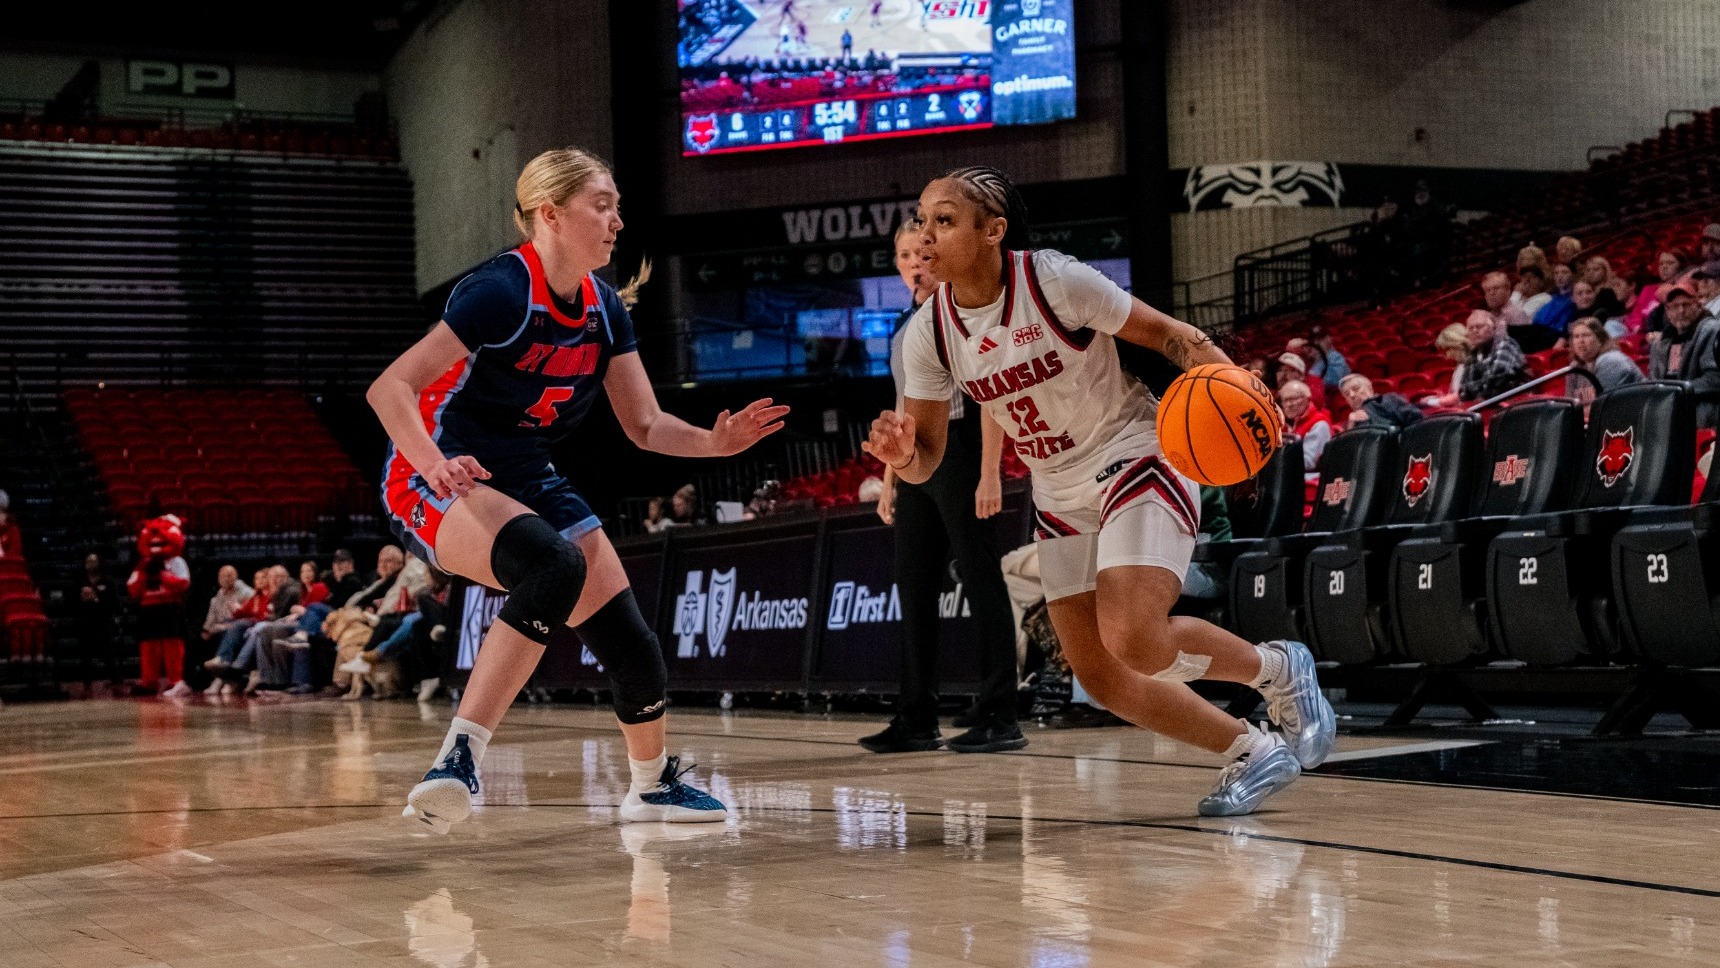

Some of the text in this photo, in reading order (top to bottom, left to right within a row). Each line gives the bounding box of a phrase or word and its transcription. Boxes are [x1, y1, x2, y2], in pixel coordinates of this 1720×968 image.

[995, 18, 1067, 42] GARNER
[128, 60, 230, 94] PP
[814, 100, 856, 126] 5:54
[928, 93, 940, 111] 2
[1011, 323, 1044, 347] SBC
[965, 350, 1064, 402] RKANSAS
[1005, 395, 1051, 437] 12
[1015, 429, 1076, 460] STATE
[1240, 408, 1272, 461] NCAA
[1418, 563, 1433, 590] 21
[1519, 557, 1538, 585] 22
[1646, 553, 1669, 583] 23
[1254, 574, 1266, 598] 19
[1329, 570, 1345, 596] 20
[732, 590, 808, 631] Arkansas
[851, 585, 887, 624] First
